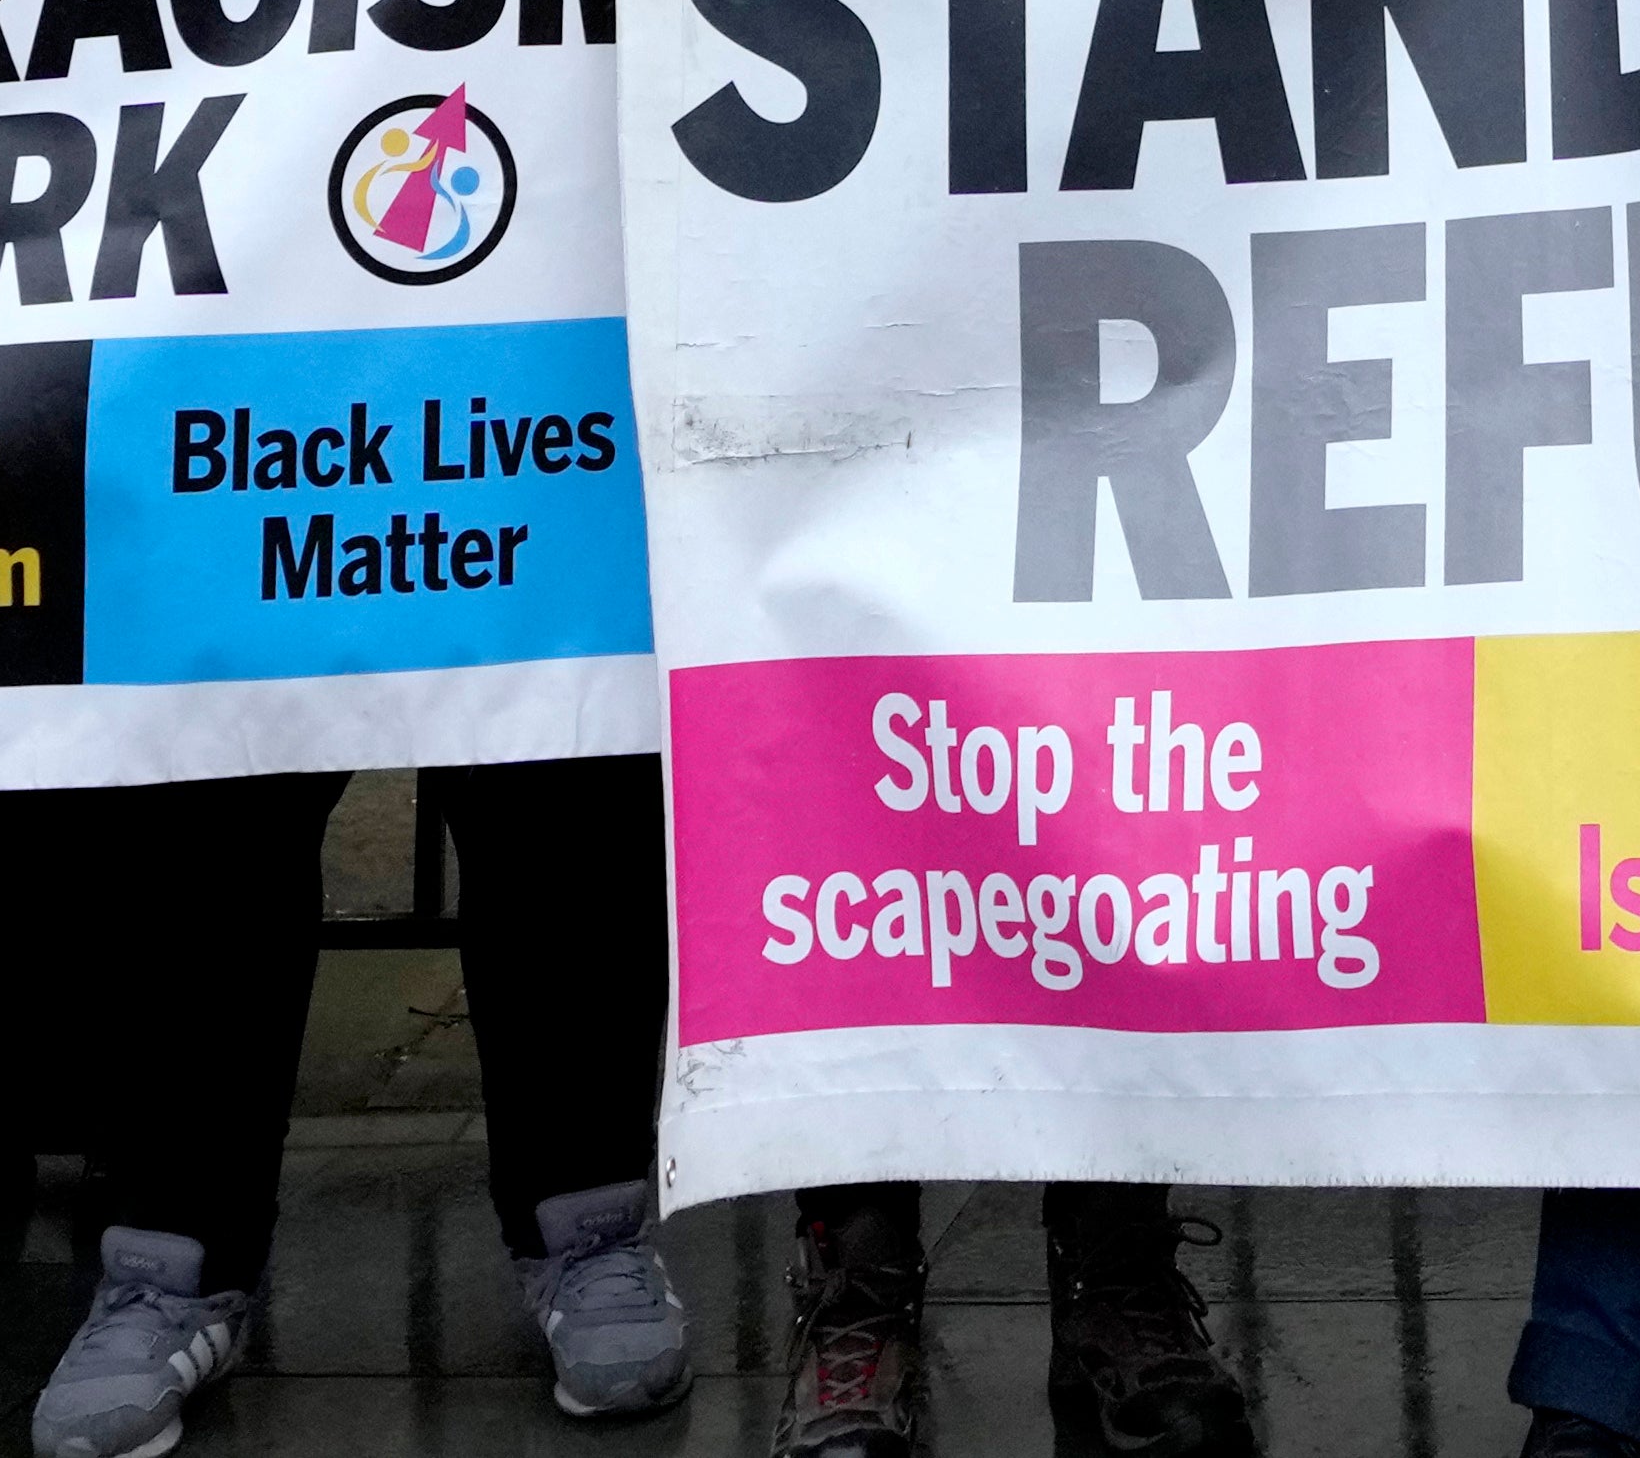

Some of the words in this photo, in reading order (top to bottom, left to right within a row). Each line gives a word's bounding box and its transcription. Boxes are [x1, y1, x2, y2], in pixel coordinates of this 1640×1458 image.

[173, 403, 392, 493] Black
[424, 398, 615, 481] Lives
[262, 513, 528, 600] Matter
[873, 693, 1073, 845] Stop
[1107, 691, 1261, 812] the
[762, 836, 1379, 990] scapegoating
